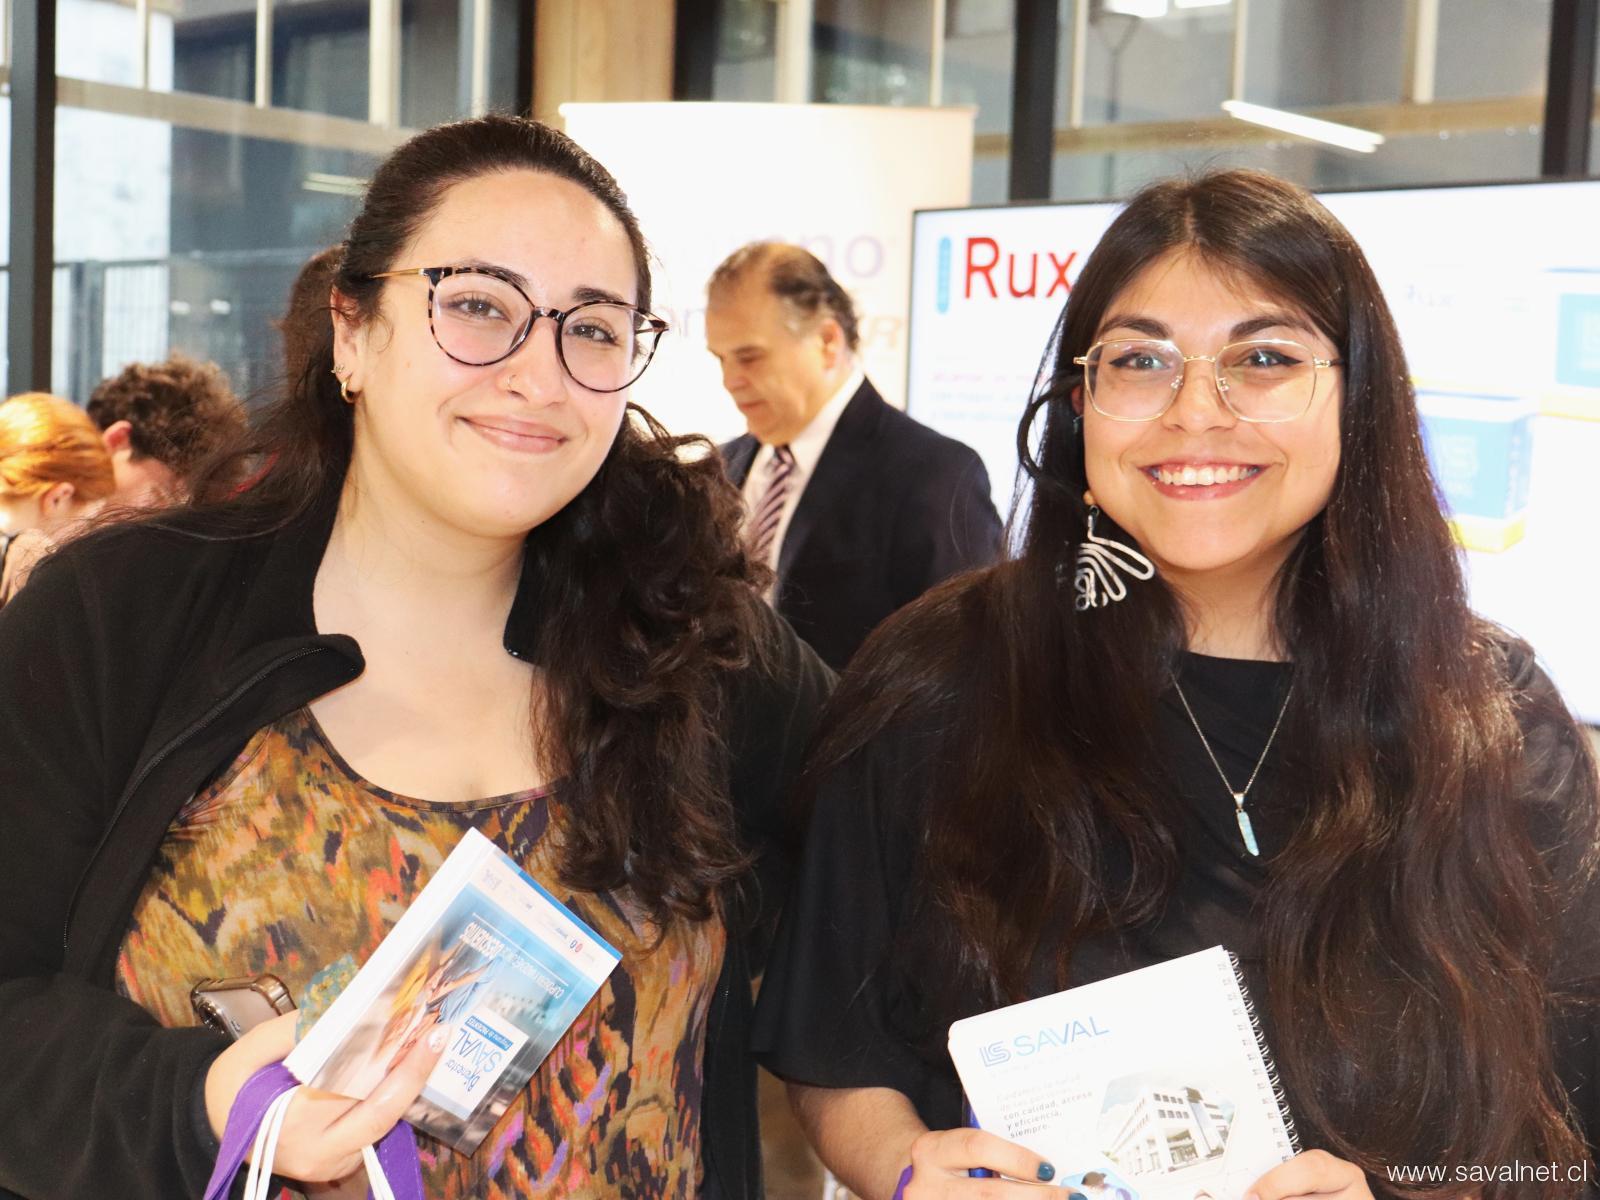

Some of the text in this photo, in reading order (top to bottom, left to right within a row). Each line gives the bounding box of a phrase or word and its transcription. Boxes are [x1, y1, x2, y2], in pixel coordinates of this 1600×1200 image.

[965, 237, 1077, 298] Rux
[452, 1027, 503, 1073] SAVAL
[1013, 1015, 1110, 1056] SAVAL
[1003, 1111, 1020, 1121] con
[1062, 1091, 1093, 1105] acceso
